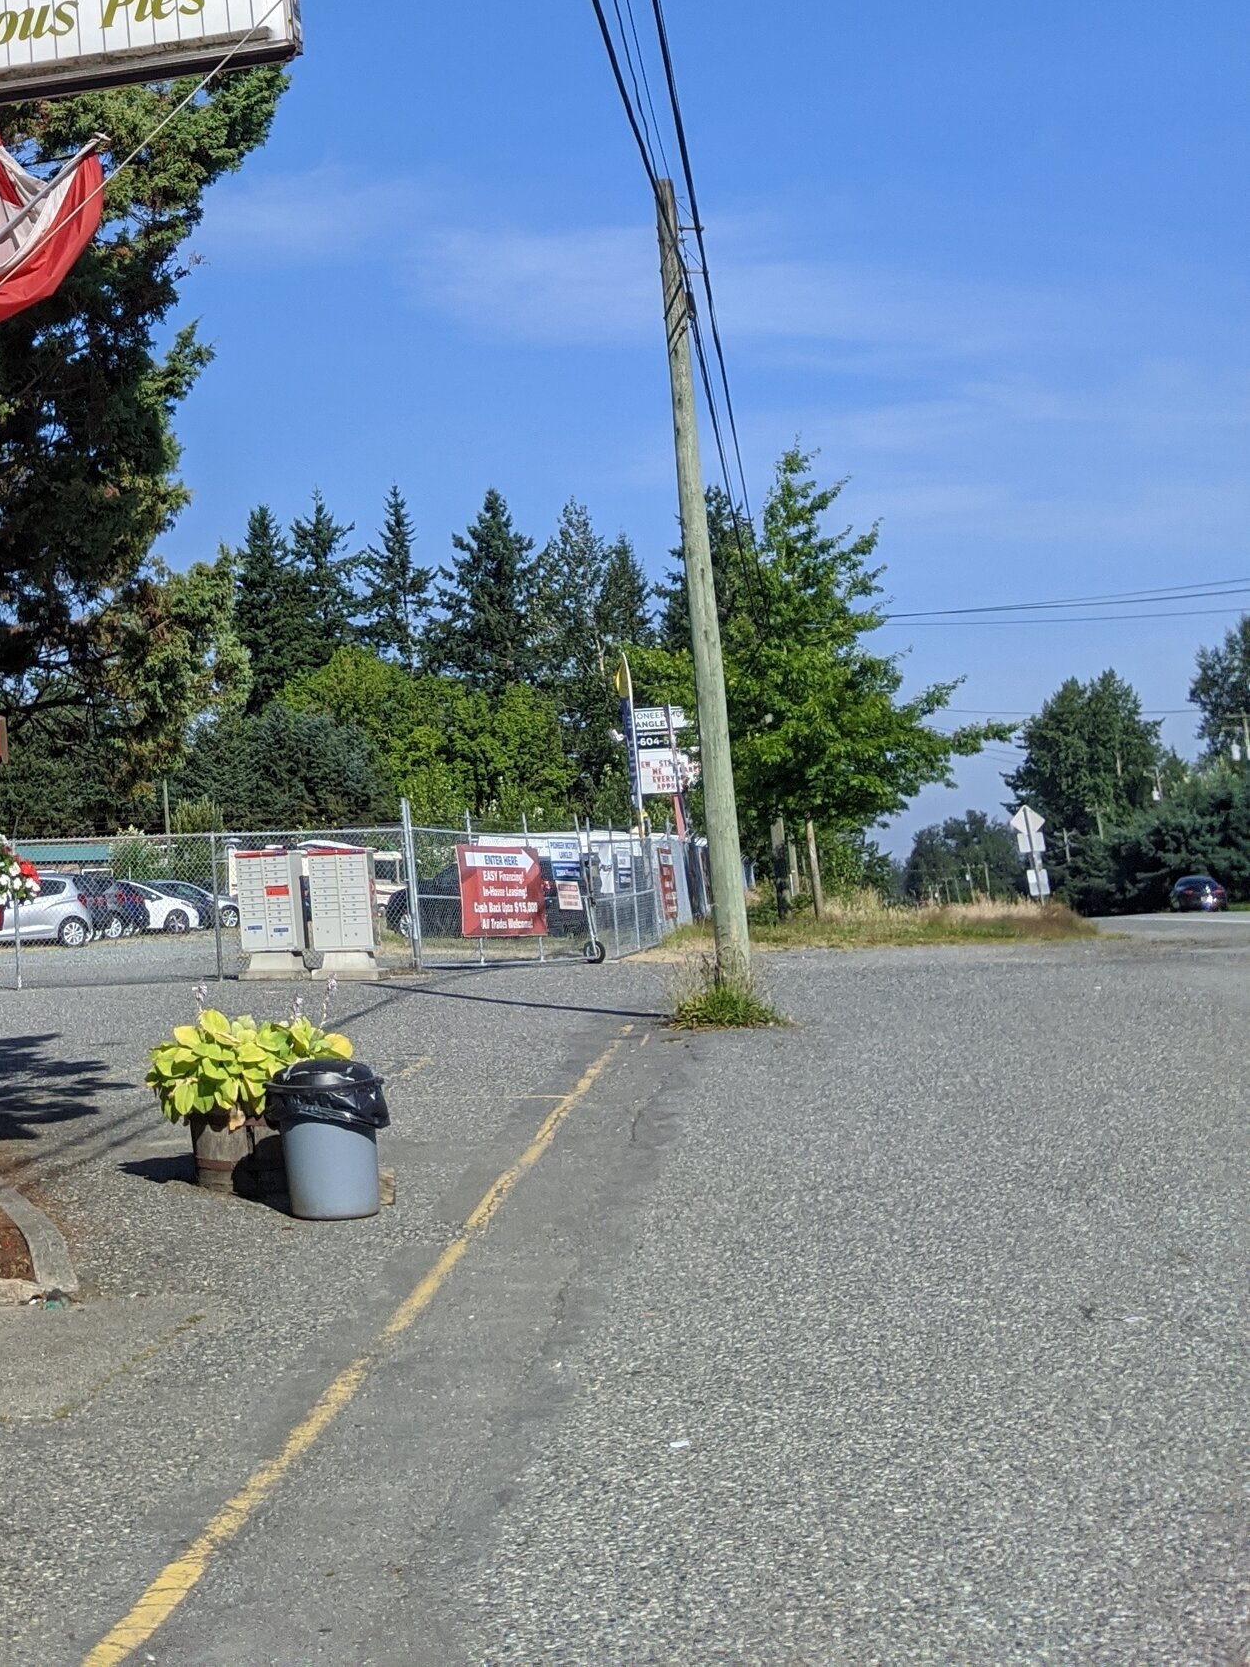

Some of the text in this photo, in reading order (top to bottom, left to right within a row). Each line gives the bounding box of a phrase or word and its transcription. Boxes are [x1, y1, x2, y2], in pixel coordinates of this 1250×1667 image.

[635, 720, 666, 728] ANGLE
[484, 855, 518, 866] ENTER HERE
[482, 870, 525, 884] EASY Financing!
[474, 901, 488, 913] Cash
[488, 901, 501, 913] Back
[482, 918, 490, 929] All
